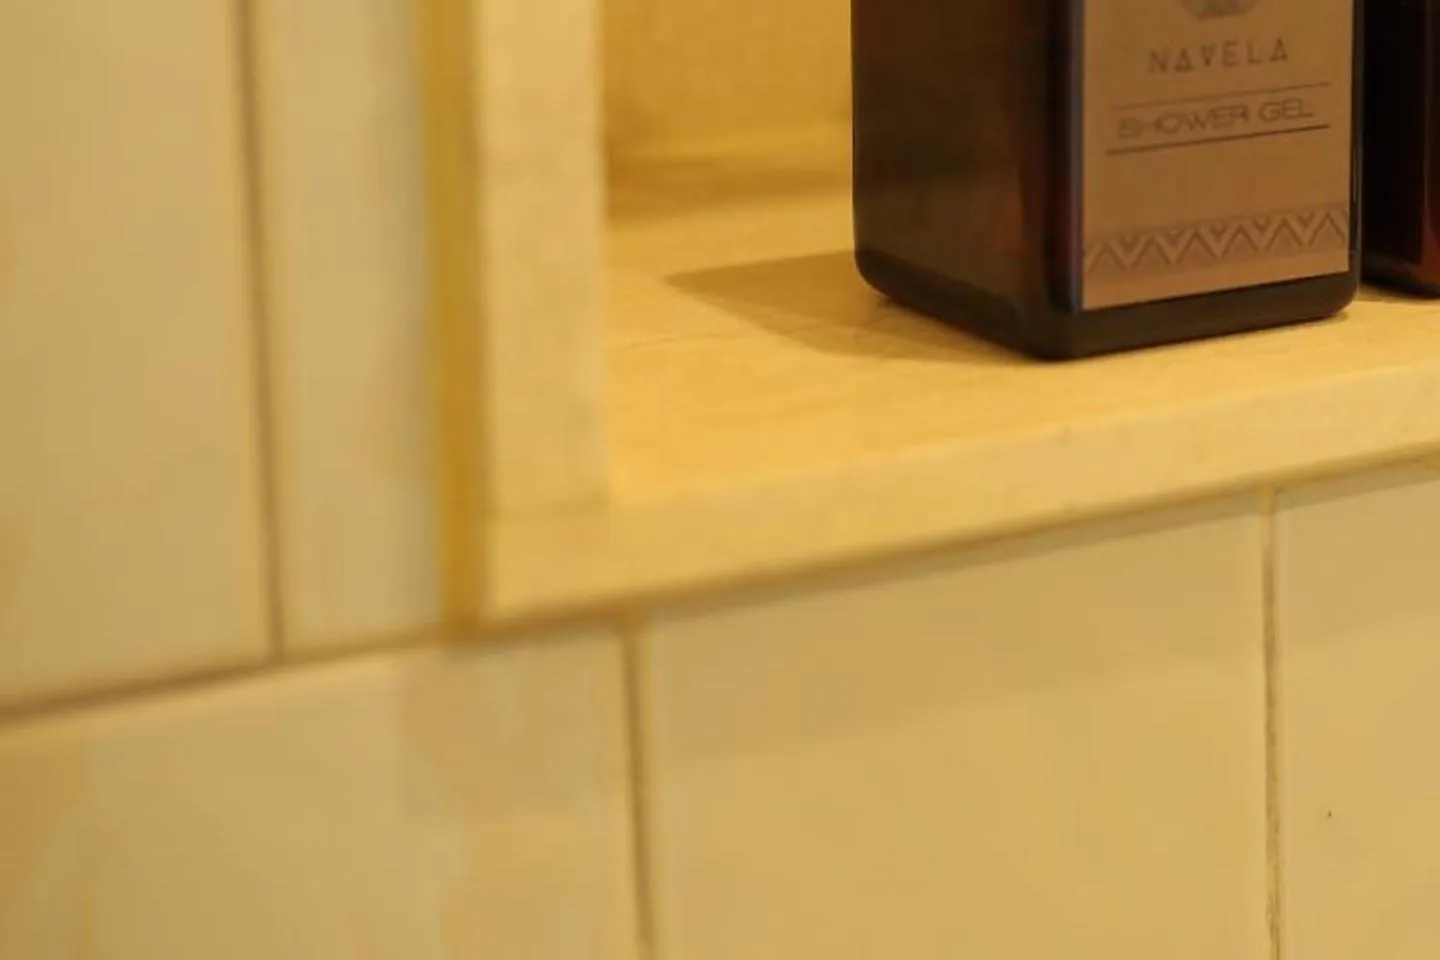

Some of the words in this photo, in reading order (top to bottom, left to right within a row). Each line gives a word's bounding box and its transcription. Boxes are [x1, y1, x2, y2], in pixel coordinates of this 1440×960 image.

[1150, 37, 1289, 74] NAVELA
[1117, 104, 1249, 140] SHOWER
[1259, 97, 1315, 124] GEL
